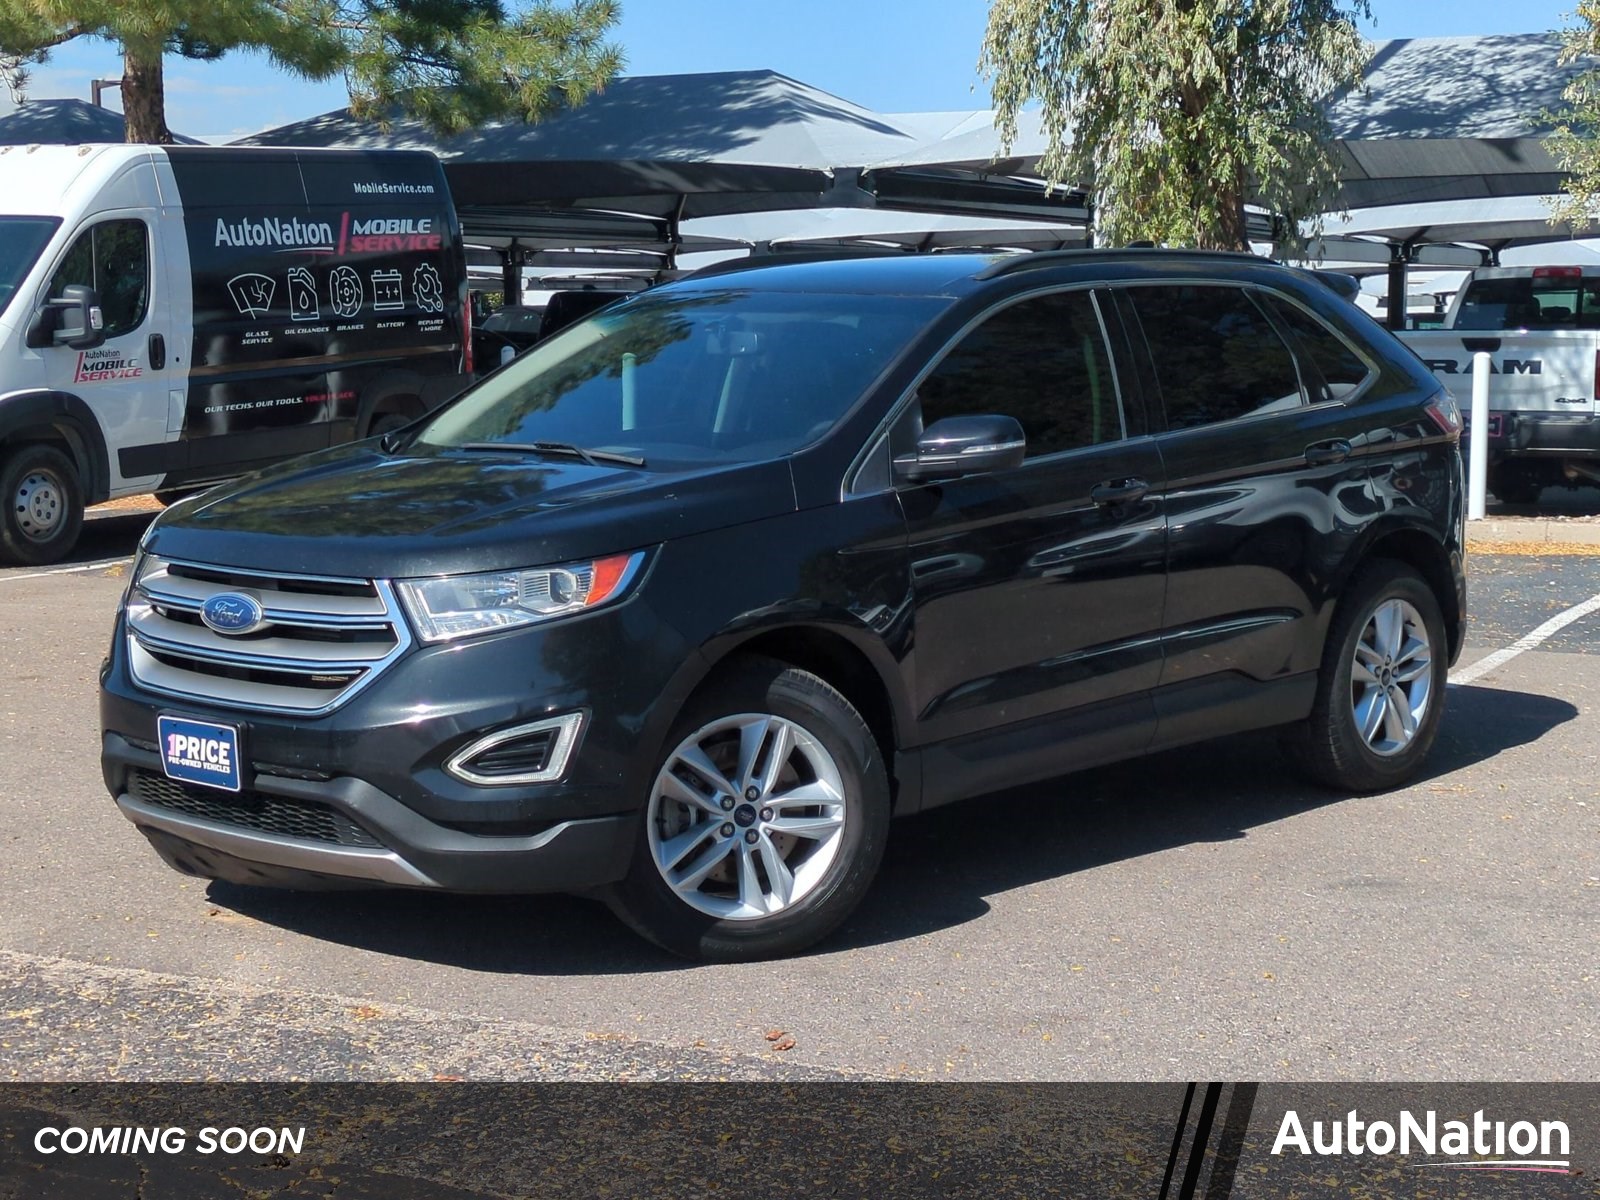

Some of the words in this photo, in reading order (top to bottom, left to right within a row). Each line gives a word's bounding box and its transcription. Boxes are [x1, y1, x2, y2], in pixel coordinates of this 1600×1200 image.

[353, 182, 434, 194] MobileService.com
[215, 217, 333, 247] AutoNation
[352, 219, 432, 235] MOBILE
[351, 234, 441, 252] SERVICE
[297, 326, 330, 334] CHANGES
[377, 321, 405, 329] BATTERY
[242, 337, 273, 345] SERVICE
[245, 330, 270, 338] GLASS
[85, 349, 120, 359] AutoNation
[82, 359, 138, 372] MOBILE
[79, 368, 143, 382] SERVICE
[204, 405, 223, 413] OUR
[225, 402, 254, 411] TECHS.
[256, 400, 273, 408] OUR
[275, 396, 303, 405] TOOLS.
[211, 600, 244, 624] Ford
[167, 733, 230, 766] 1PRICE
[168, 755, 202, 769] PRE-OWNED
[202, 761, 231, 774] VEHICLES
